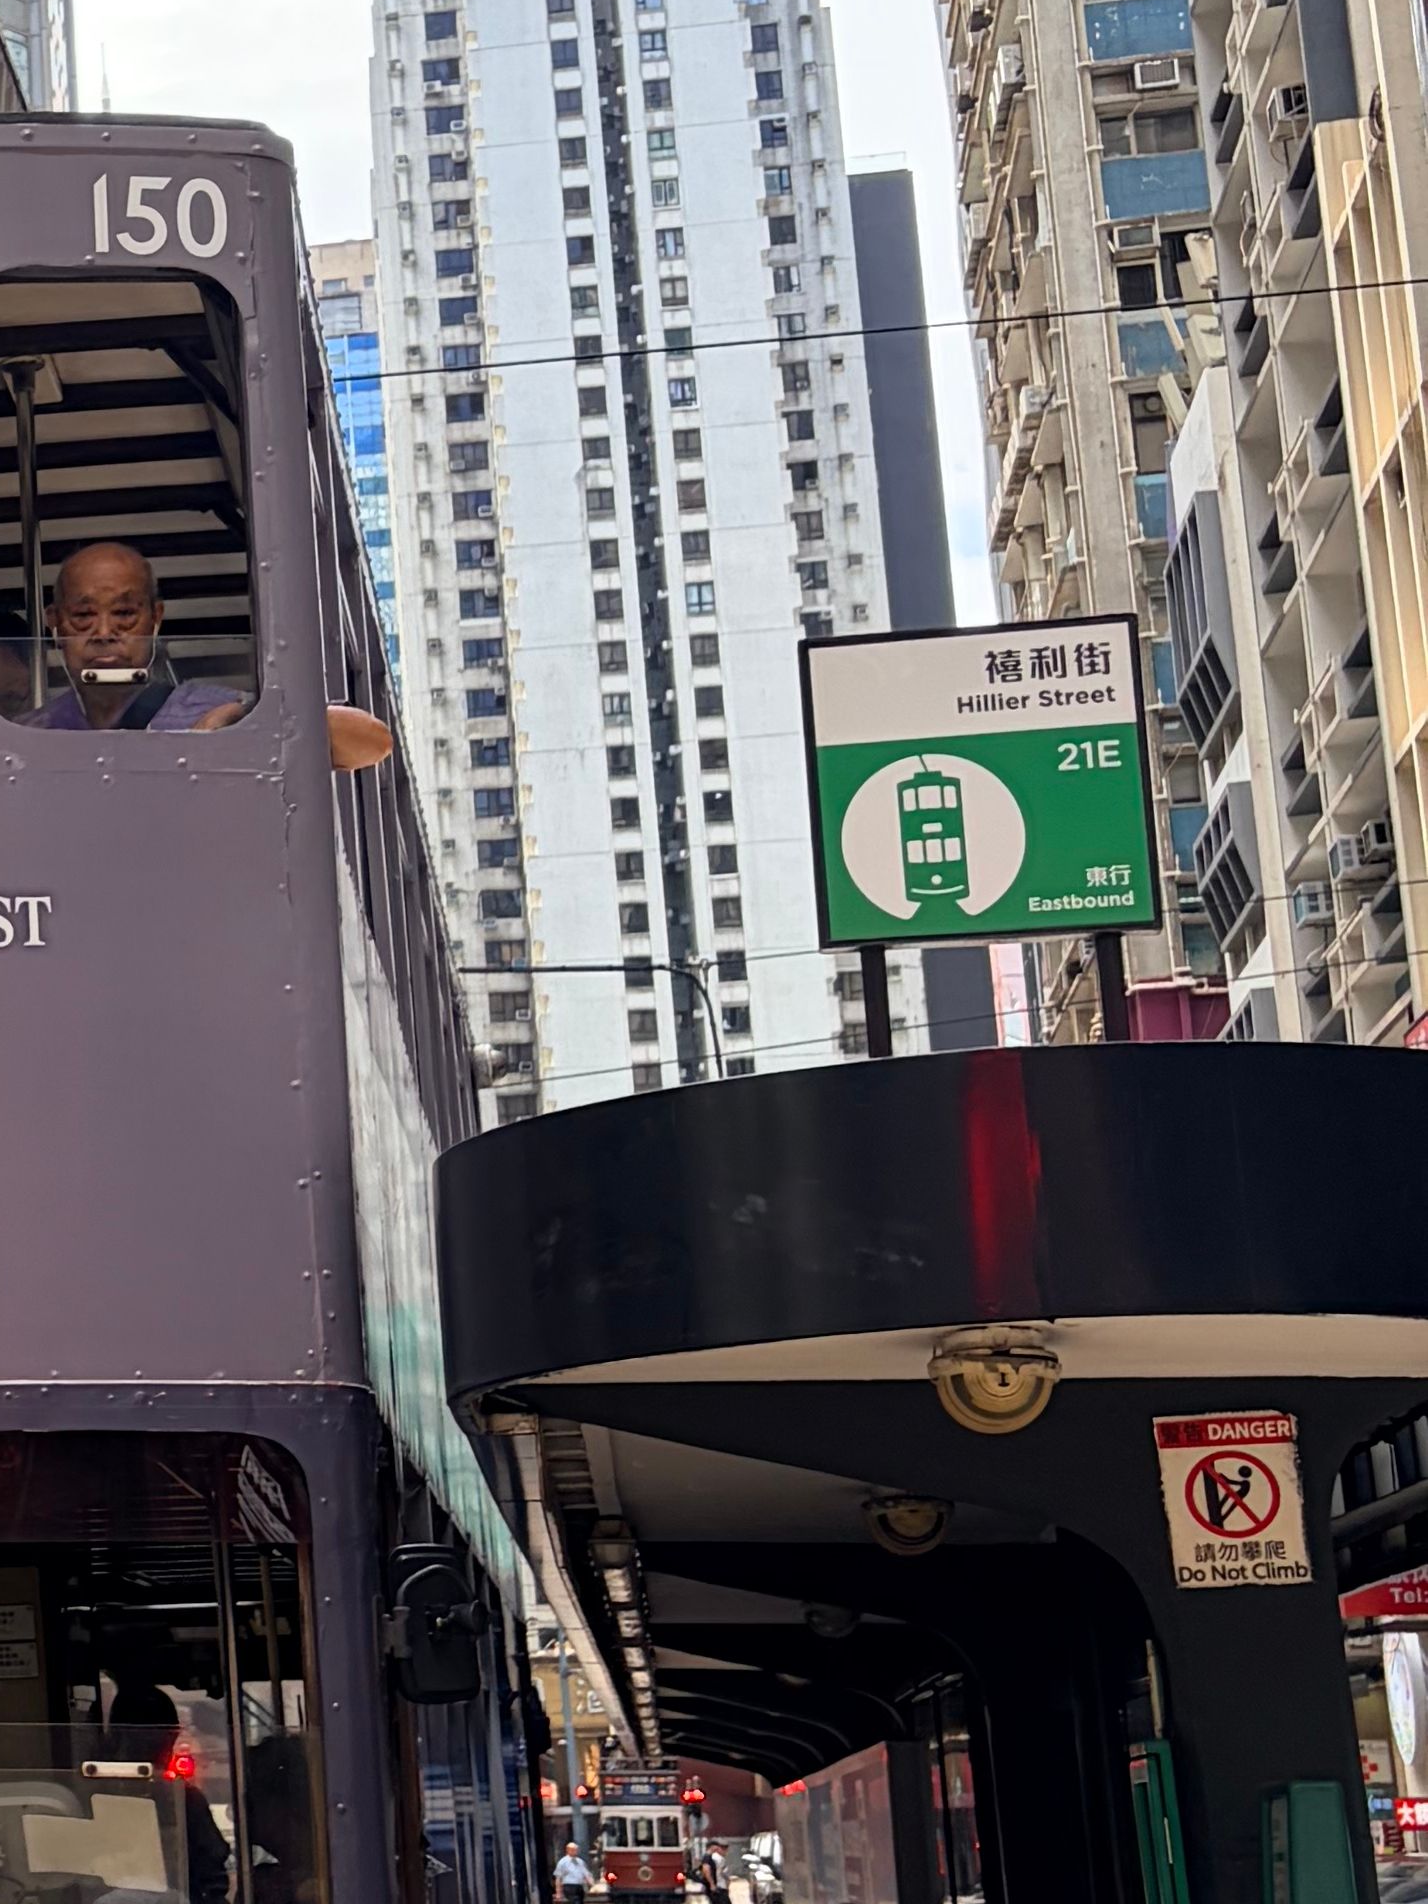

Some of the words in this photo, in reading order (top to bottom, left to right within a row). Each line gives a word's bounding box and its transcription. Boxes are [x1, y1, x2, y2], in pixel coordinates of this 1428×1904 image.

[93, 173, 229, 260] 150
[984, 642, 1112, 684] 禧利街
[957, 692, 1029, 714] Hillier
[1038, 685, 1116, 708] Street
[1057, 739, 1122, 772] 21E
[1085, 863, 1132, 888] 東行
[1028, 890, 1135, 913] Eastbound
[1207, 1419, 1291, 1441] DANGER
[1194, 1540, 1288, 1564] 請勿攀爬
[1178, 1566, 1206, 1583] Do
[1211, 1565, 1249, 1582] Not
[1252, 1560, 1310, 1581] Climb
